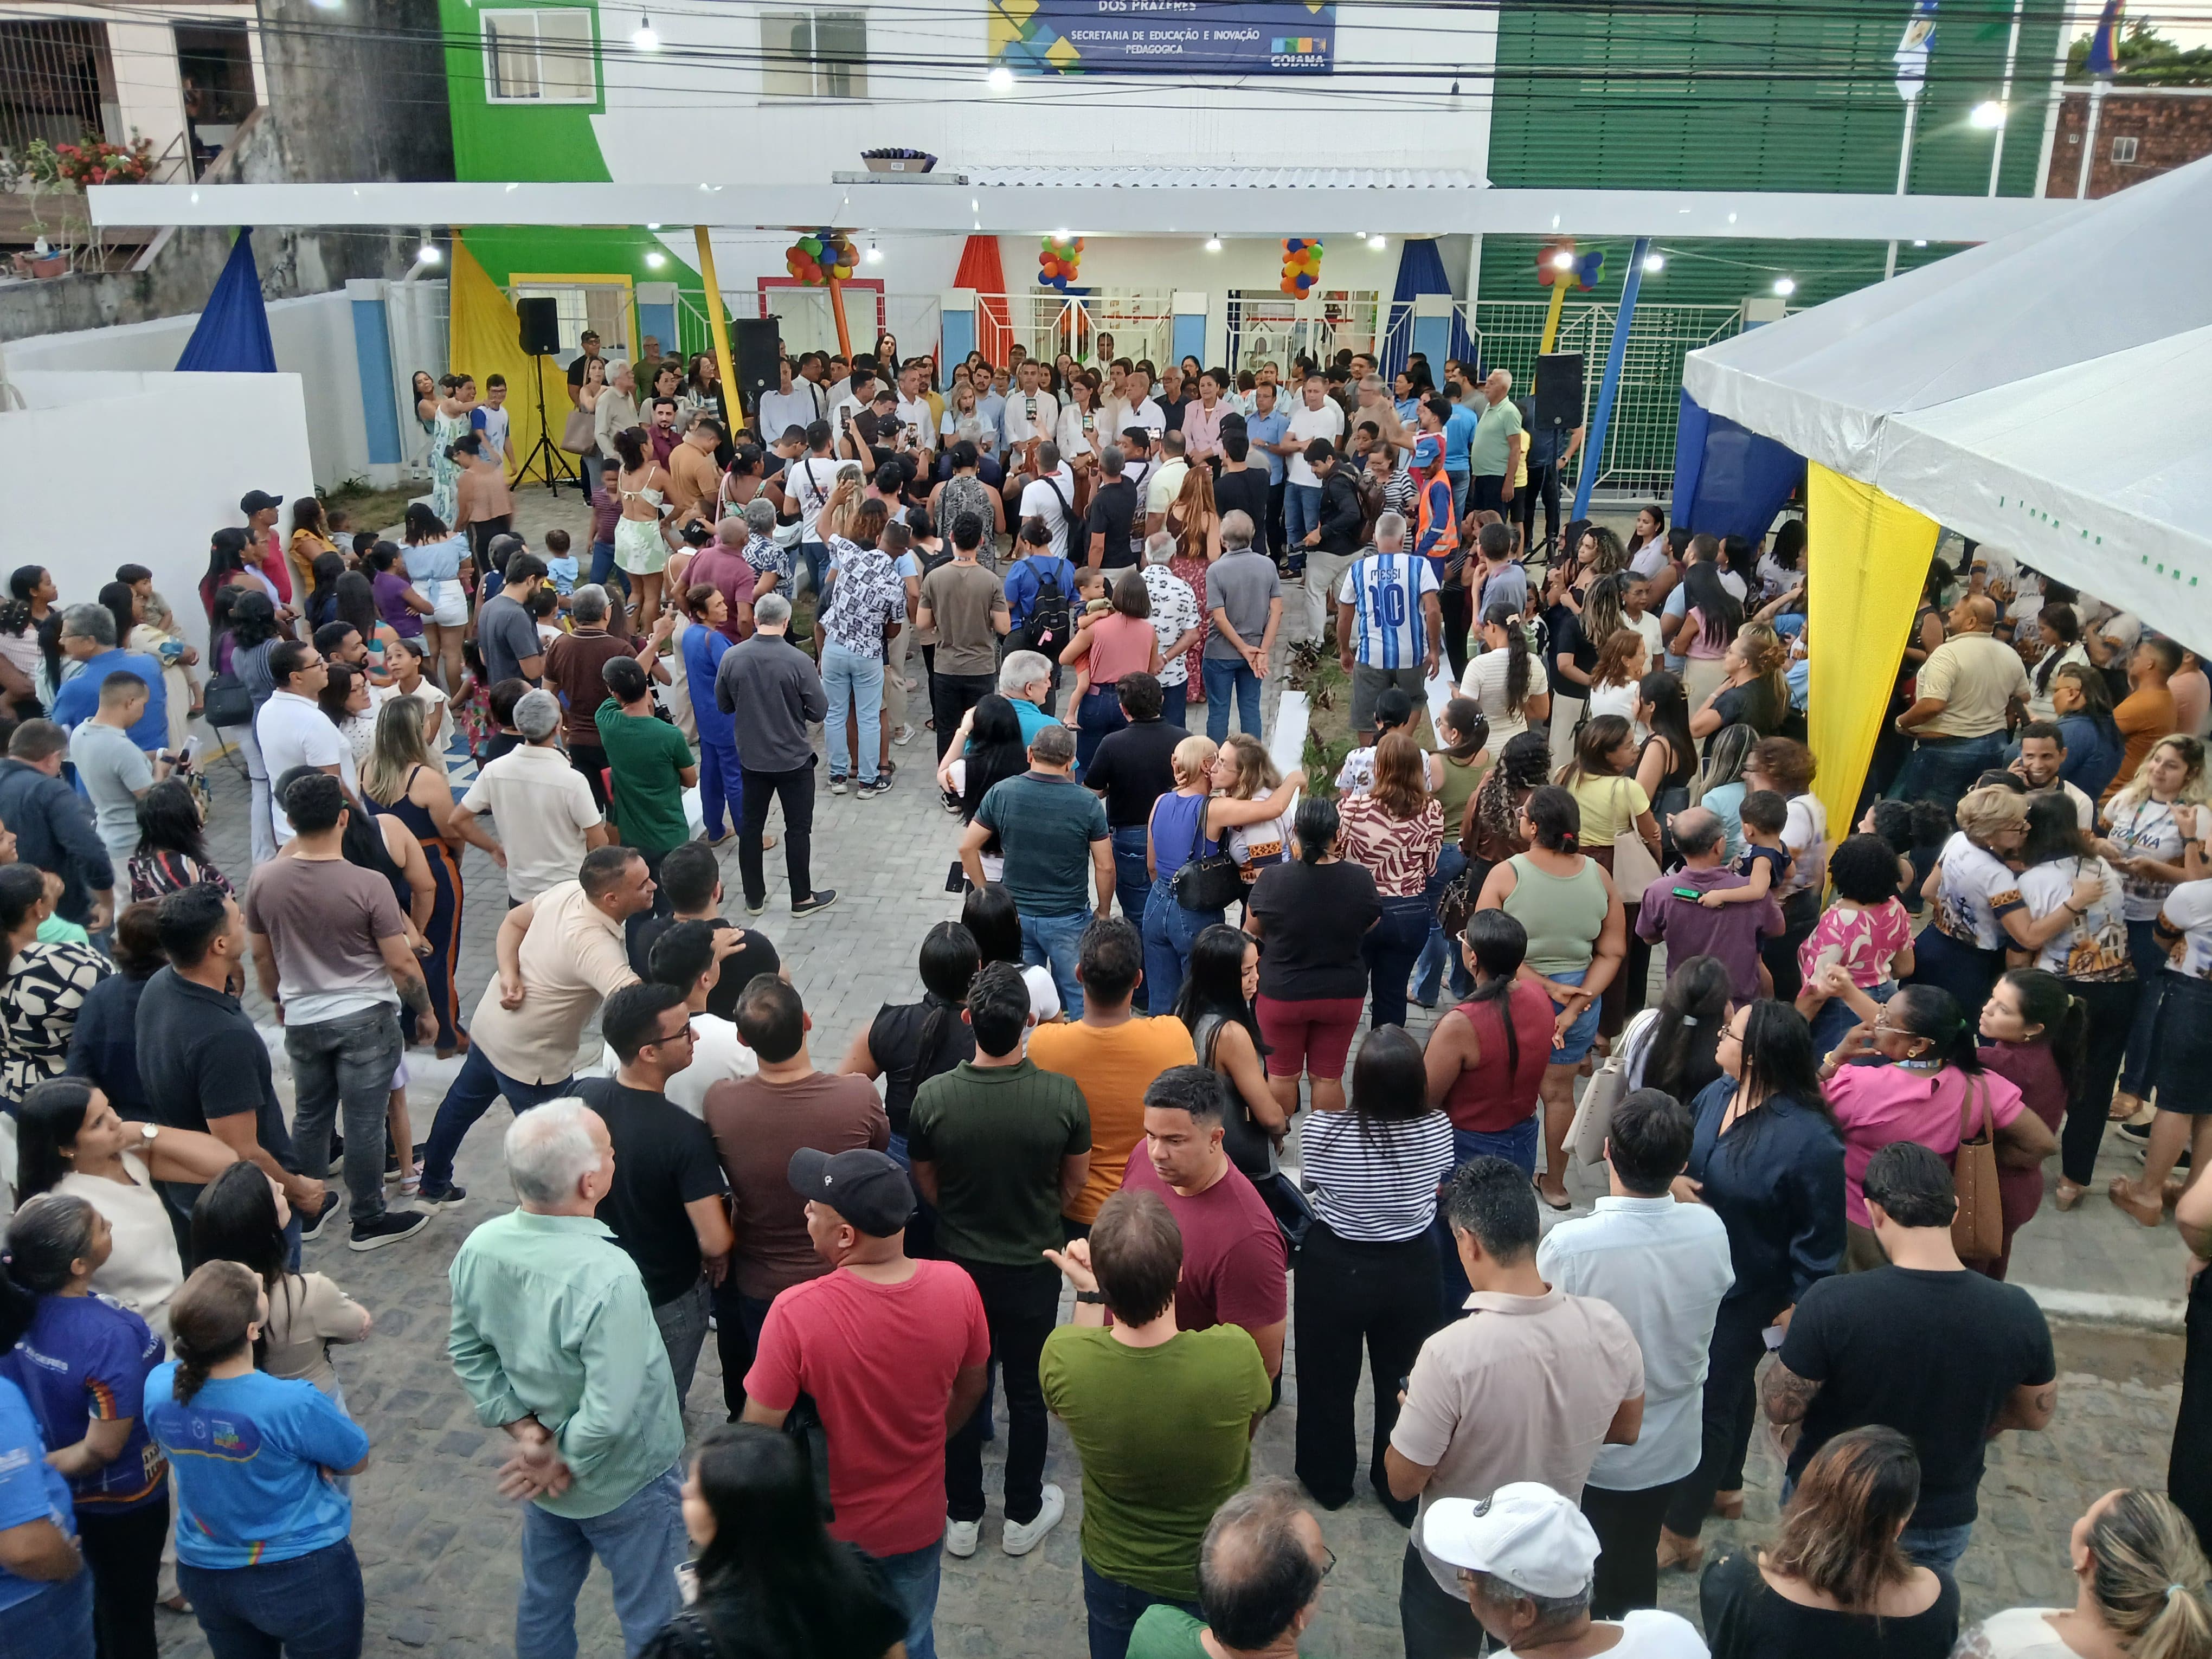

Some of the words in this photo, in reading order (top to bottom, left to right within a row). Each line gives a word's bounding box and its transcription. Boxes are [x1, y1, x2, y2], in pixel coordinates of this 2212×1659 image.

[1098, 0, 1127, 11] DOS
[1131, 0, 1197, 11] PRAZERES
[1071, 30, 1129, 40] SECRETARIA
[1132, 30, 1144, 40] DE
[1149, 28, 1199, 42] EDUCAÇÃO
[1204, 30, 1210, 40] E
[1214, 28, 1260, 42] INOVAÇÃO
[1270, 54, 1325, 67] GOIANA
[1371, 568, 1400, 581] MESSI
[1368, 583, 1405, 628] 10
